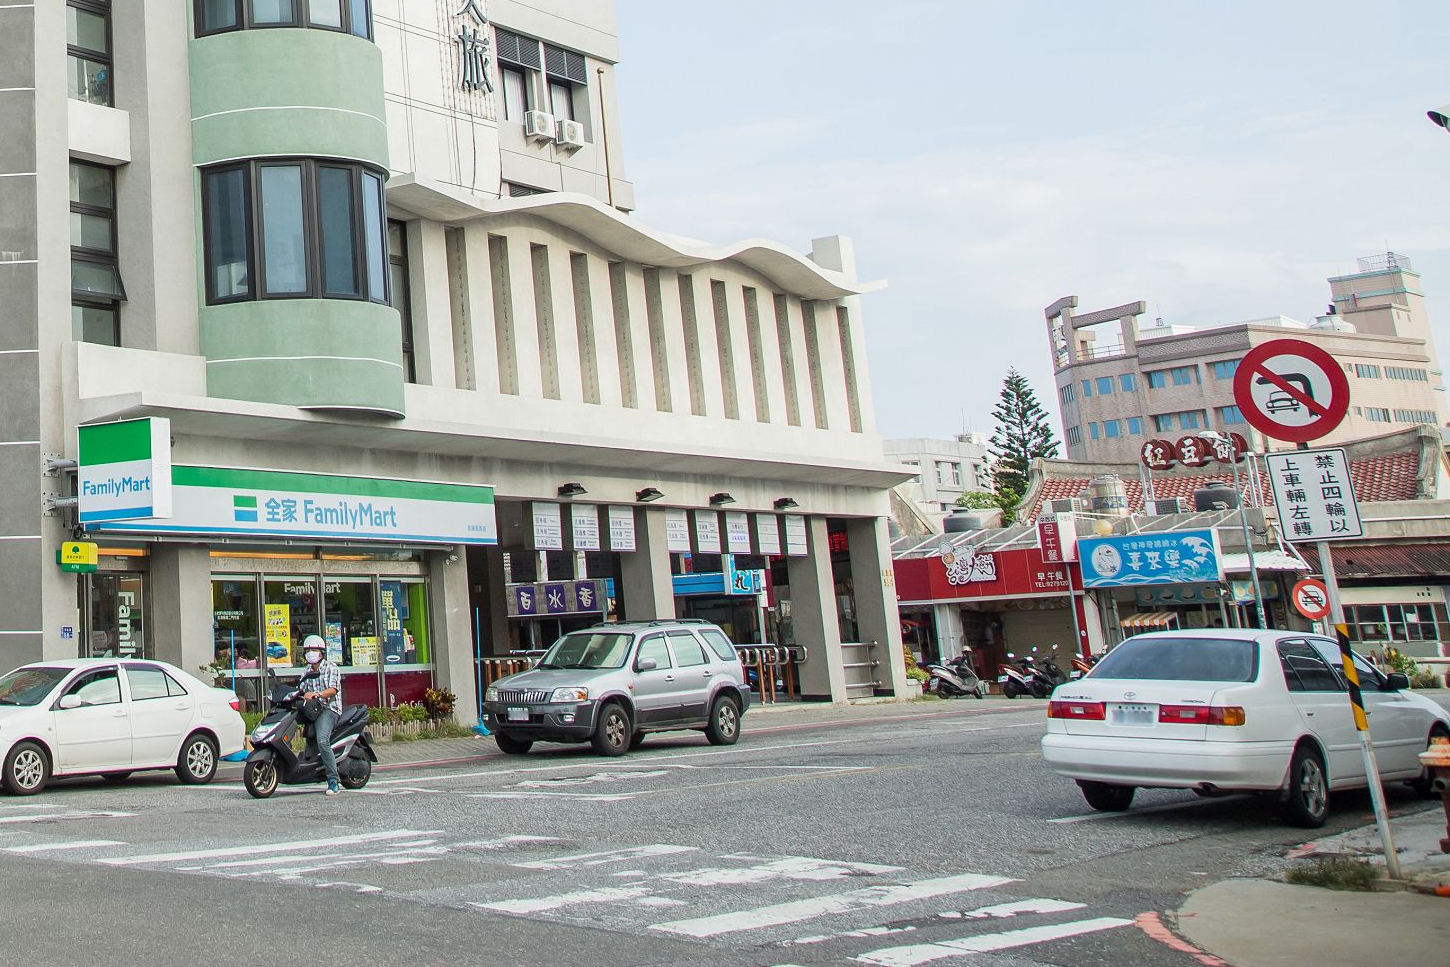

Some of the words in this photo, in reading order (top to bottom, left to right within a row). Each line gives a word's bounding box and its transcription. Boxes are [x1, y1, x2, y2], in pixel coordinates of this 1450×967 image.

[83, 476, 150, 497] FamilyMart
[265, 498, 298, 522] 全家
[303, 500, 397, 529] FamilyMart
[1280, 458, 1313, 536] 上車輛左轉
[1314, 454, 1350, 533] 禁止四輪以
